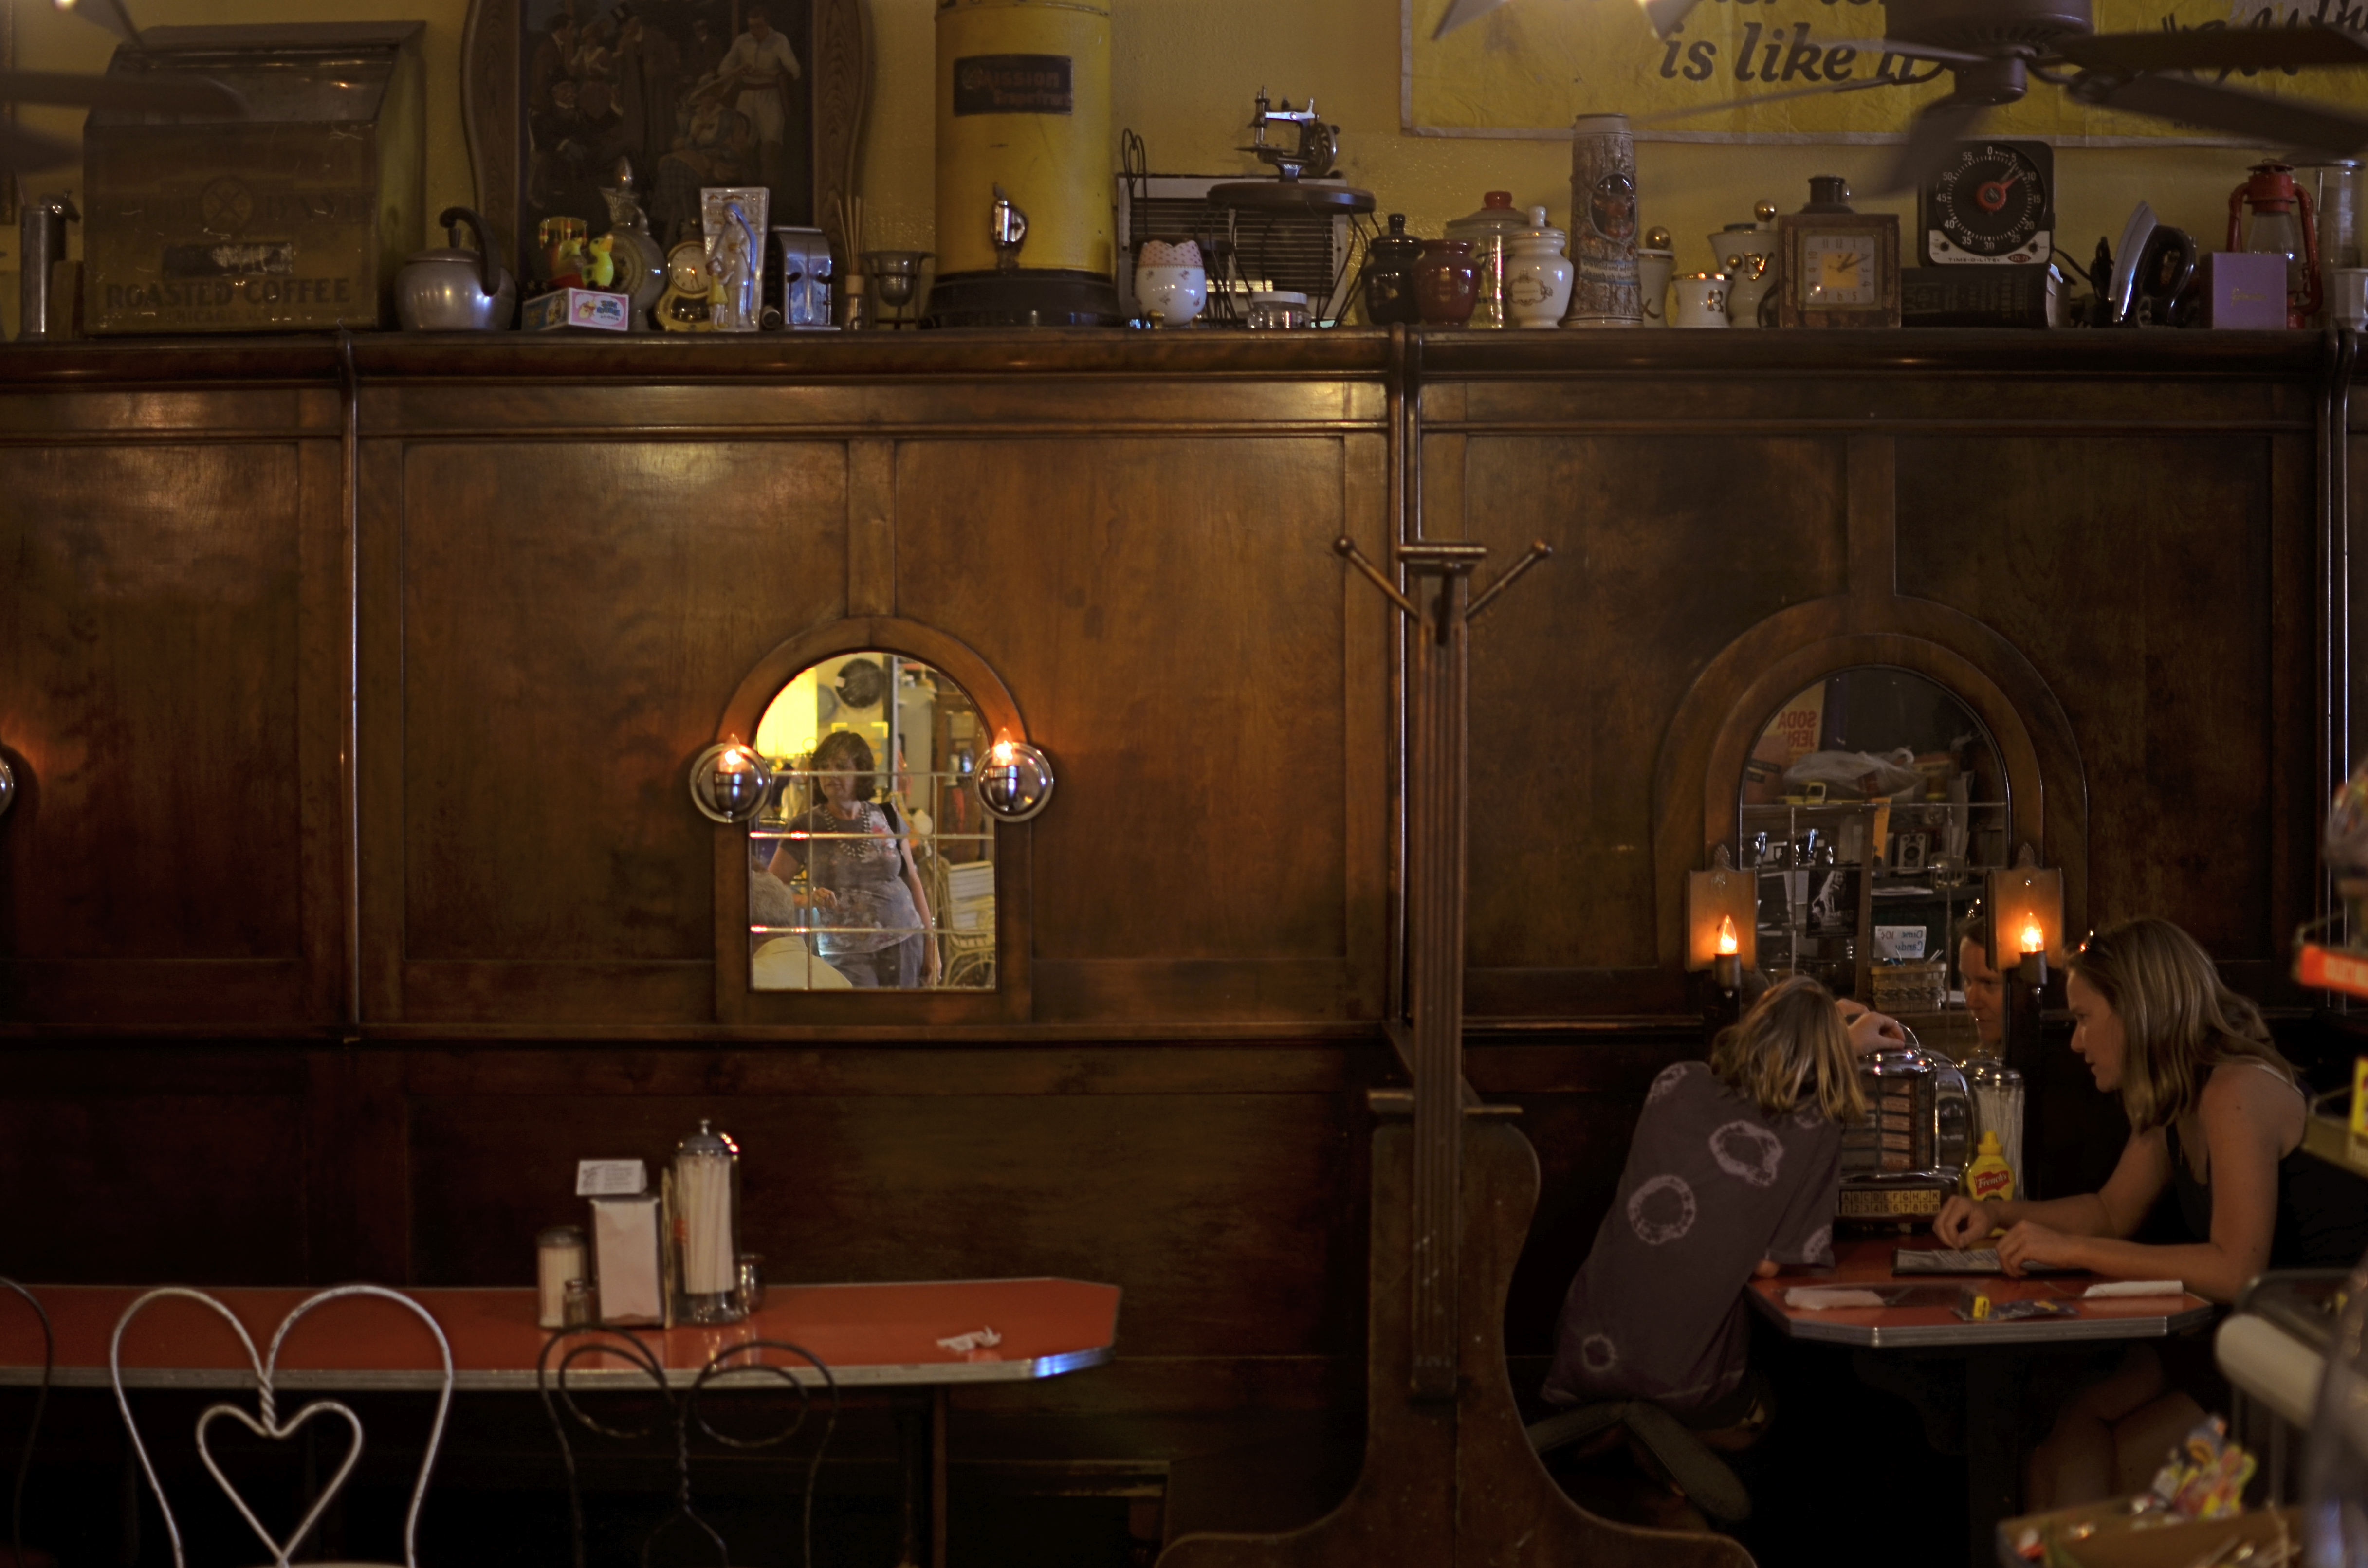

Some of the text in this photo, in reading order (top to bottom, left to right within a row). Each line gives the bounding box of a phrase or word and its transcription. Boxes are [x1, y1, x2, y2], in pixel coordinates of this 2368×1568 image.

[1660, 21, 1717, 81] is
[1734, 22, 1857, 82] like
[1987, 146, 1993, 155] 0
[1963, 152, 1972, 161] 55
[2011, 153, 2016, 162] 5
[1943, 172, 1952, 181] 50
[2027, 172, 2036, 181] 10
[1936, 194, 1946, 202] 45
[2033, 195, 2041, 203] 15
[1945, 220, 1954, 229] 40
[2024, 221, 2035, 230] 20
[1962, 236, 1972, 245] 35
[2011, 234, 2021, 243] 25
[1836, 238, 1843, 249] 12
[106, 277, 350, 309] ROASTED COFFEE
[1823, 291, 1827, 301] 7
[1853, 291, 1857, 301] 5
[1978, 1173, 2007, 1189] French's
